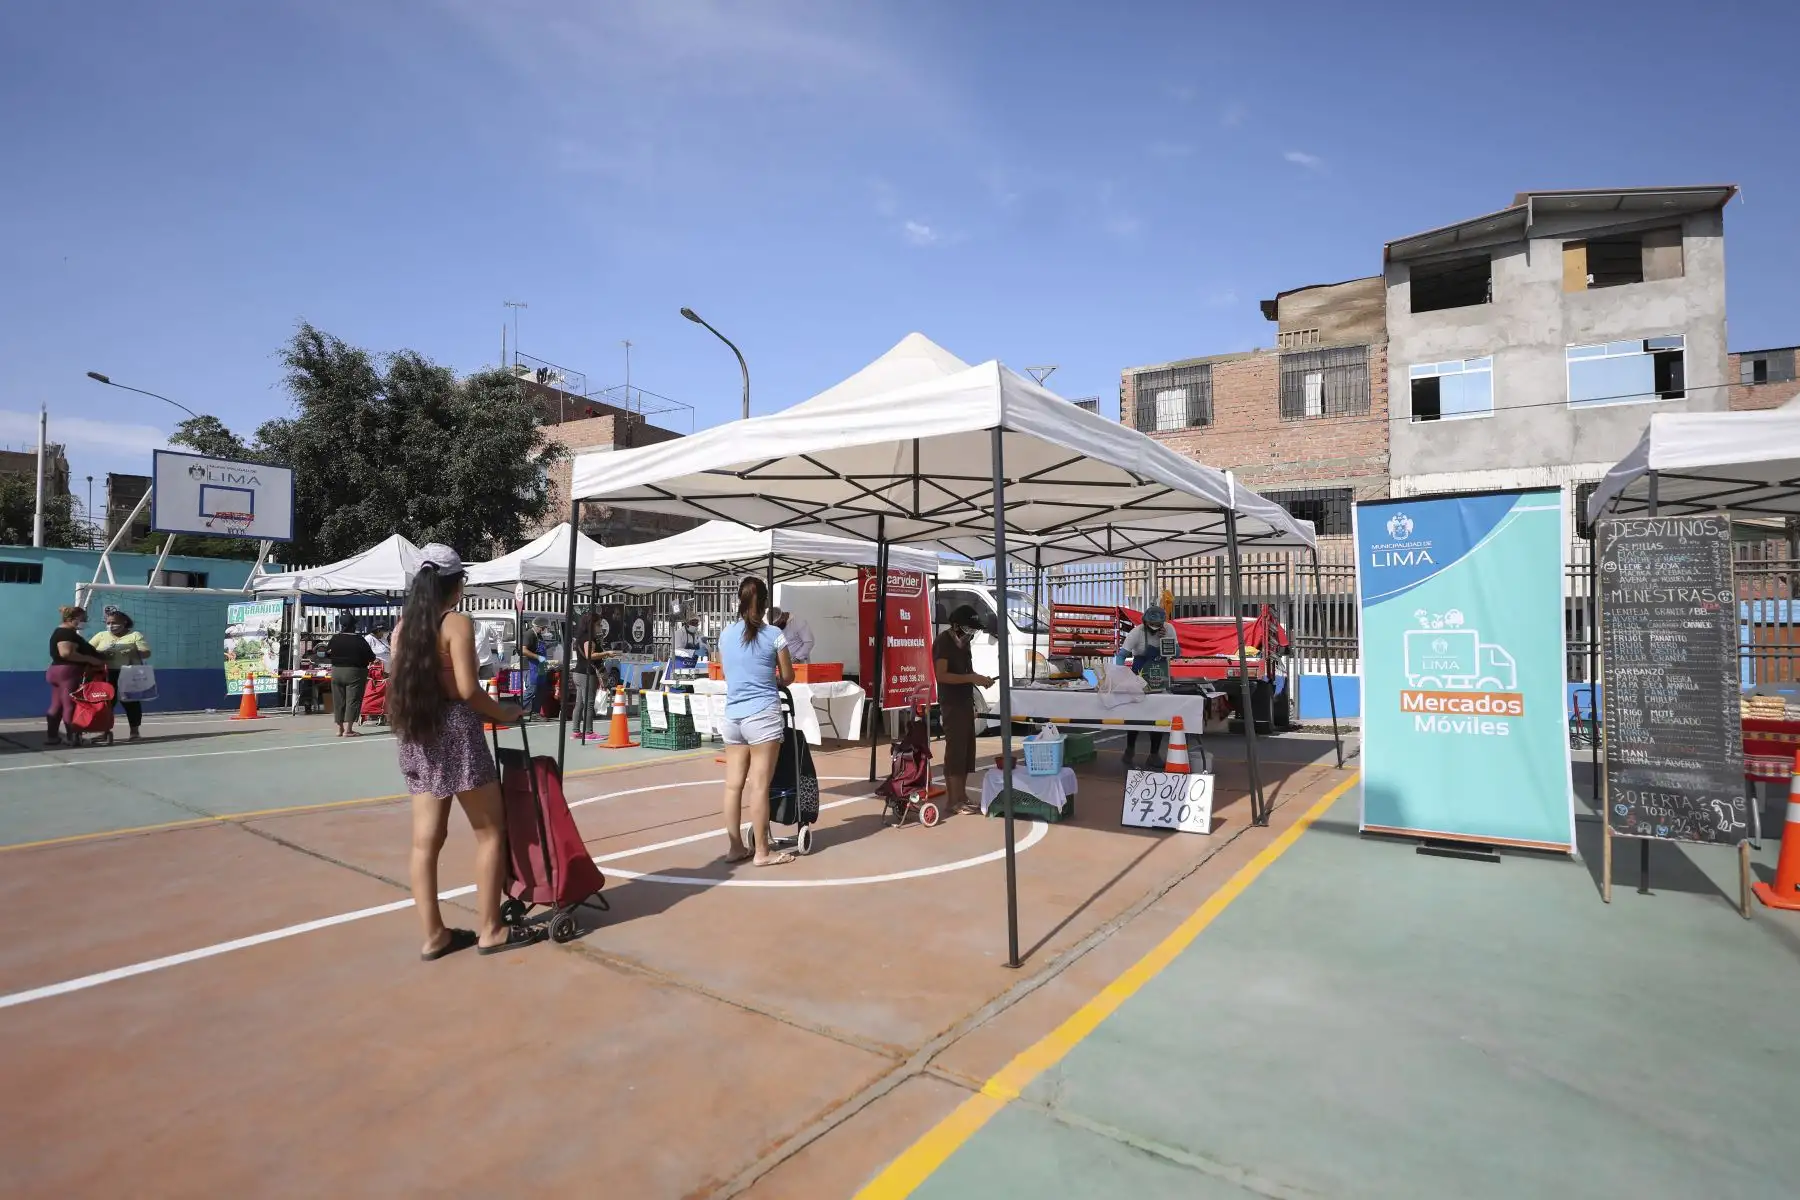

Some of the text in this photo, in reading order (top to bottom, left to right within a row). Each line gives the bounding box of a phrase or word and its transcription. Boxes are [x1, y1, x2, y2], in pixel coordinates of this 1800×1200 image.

[208, 471, 261, 486] LIMA
[1611, 519, 1718, 538] DESAYUNOS
[1371, 541, 1422, 550] MUNICIPALIDAD
[1372, 550, 1434, 567] LIMA
[1618, 563, 1643, 571] LECHE
[887, 575, 919, 587] caryder
[1619, 576, 1648, 584] AVENA
[1612, 588, 1717, 603] MENESTRAS
[244, 602, 281, 615] GRANJITA
[1422, 660, 1460, 670] LIMA
[1614, 668, 1665, 676] GARBANZO
[1402, 692, 1521, 714] Mercados
[1617, 708, 1643, 717] TRIGO
[1415, 714, 1510, 736] Móviles
[1626, 790, 1694, 810] OFERTA
[1140, 800, 1191, 823] 7.20
[1642, 805, 1676, 817] TODO
